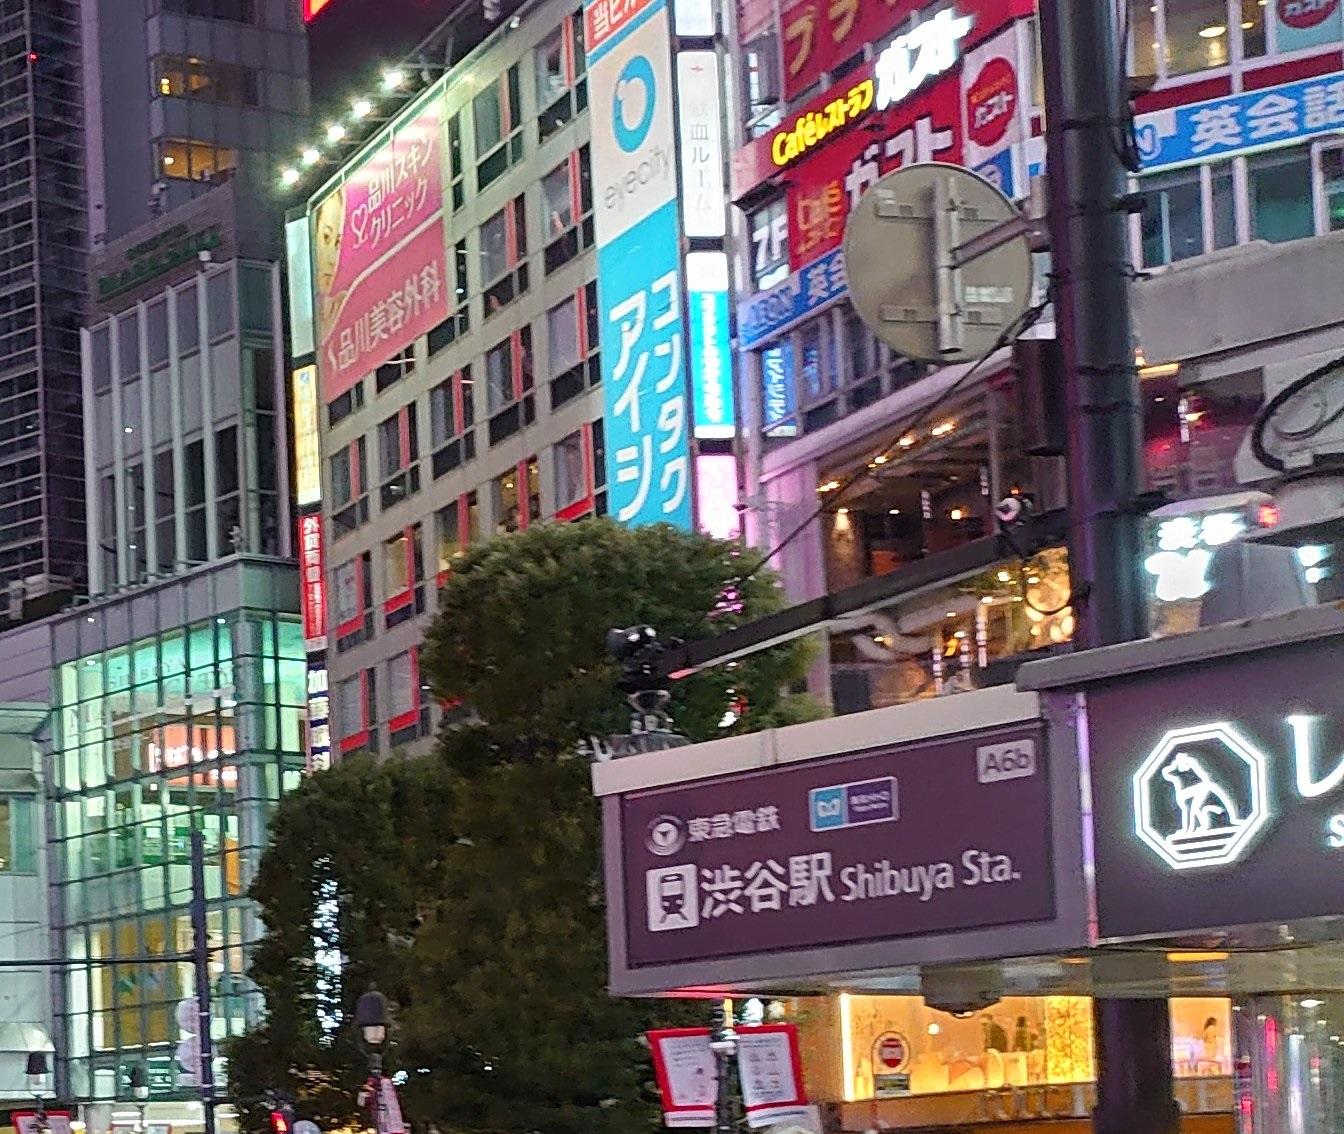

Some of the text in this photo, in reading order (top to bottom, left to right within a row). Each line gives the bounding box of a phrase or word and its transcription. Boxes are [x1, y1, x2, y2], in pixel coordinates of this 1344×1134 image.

[370, 177, 429, 249] クリニック
[338, 261, 442, 371] 品川美容外科
[983, 742, 1032, 775] A6b
[687, 805, 782, 843] 東急電鉄
[699, 849, 1023, 919] 渋谷駅 Shibuya Sta.
